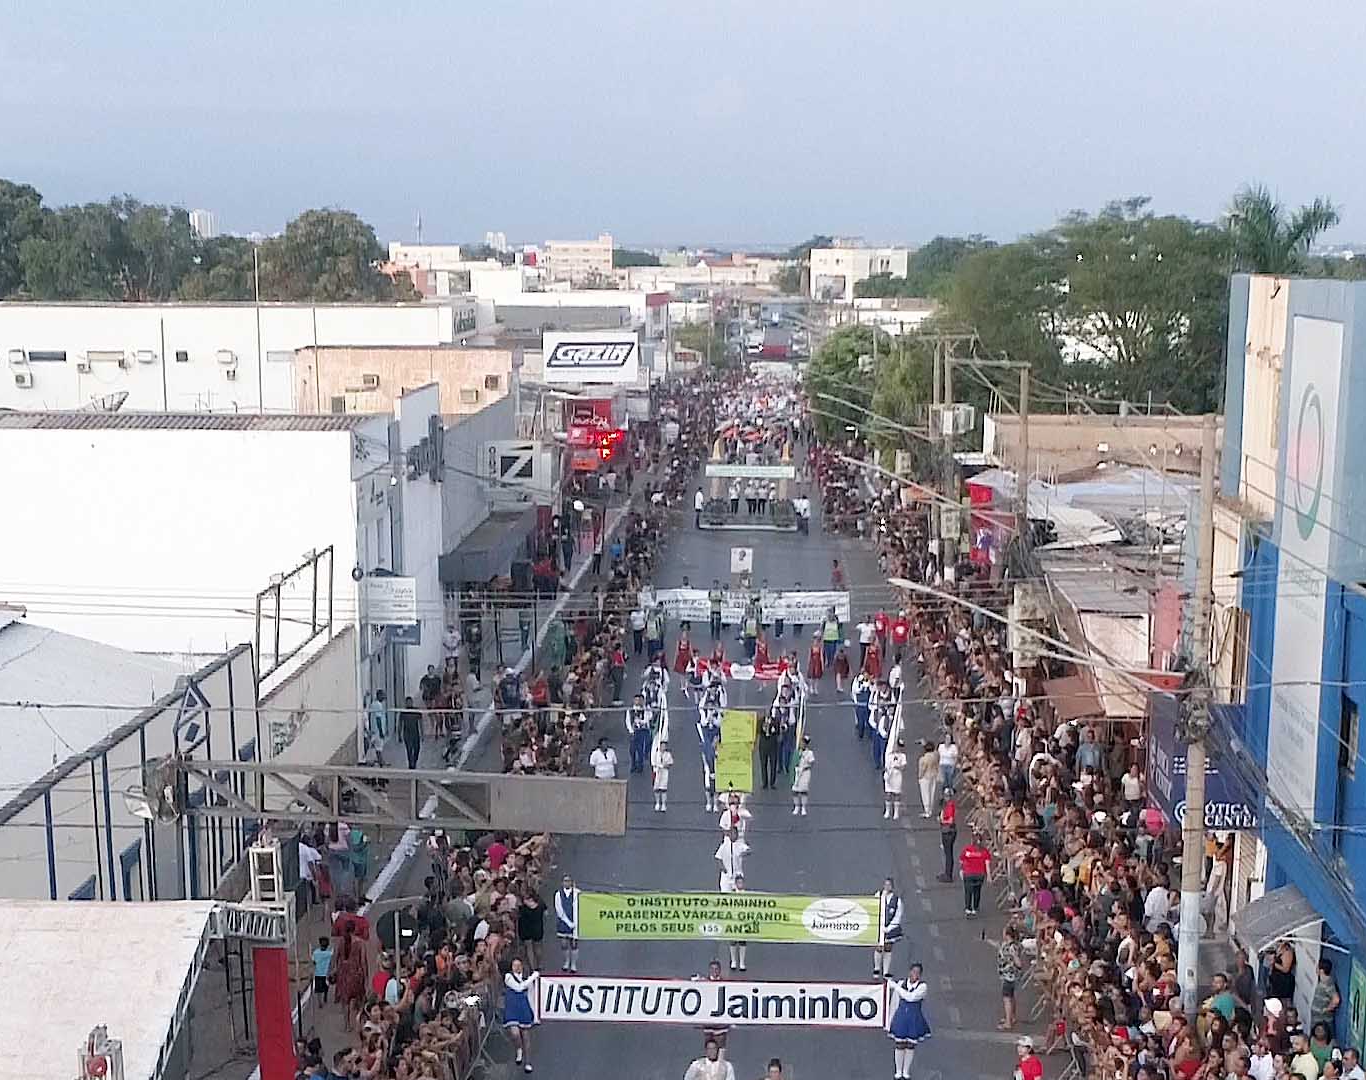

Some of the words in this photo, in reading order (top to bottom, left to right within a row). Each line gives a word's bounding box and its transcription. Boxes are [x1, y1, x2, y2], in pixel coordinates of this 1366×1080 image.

[1205, 799, 1250, 815] ÓTICA
[627, 898, 636, 908] O
[640, 898, 709, 908] INSTITUTO
[710, 898, 777, 909] JAIMINHO
[599, 909, 680, 920] PARABENIZA
[737, 911, 791, 922] GRANDE
[616, 922, 657, 933] PELOS
[661, 923, 695, 933] SEUS
[545, 985, 702, 1016] INSTITUTO
[710, 986, 879, 1020] Jaiminho
